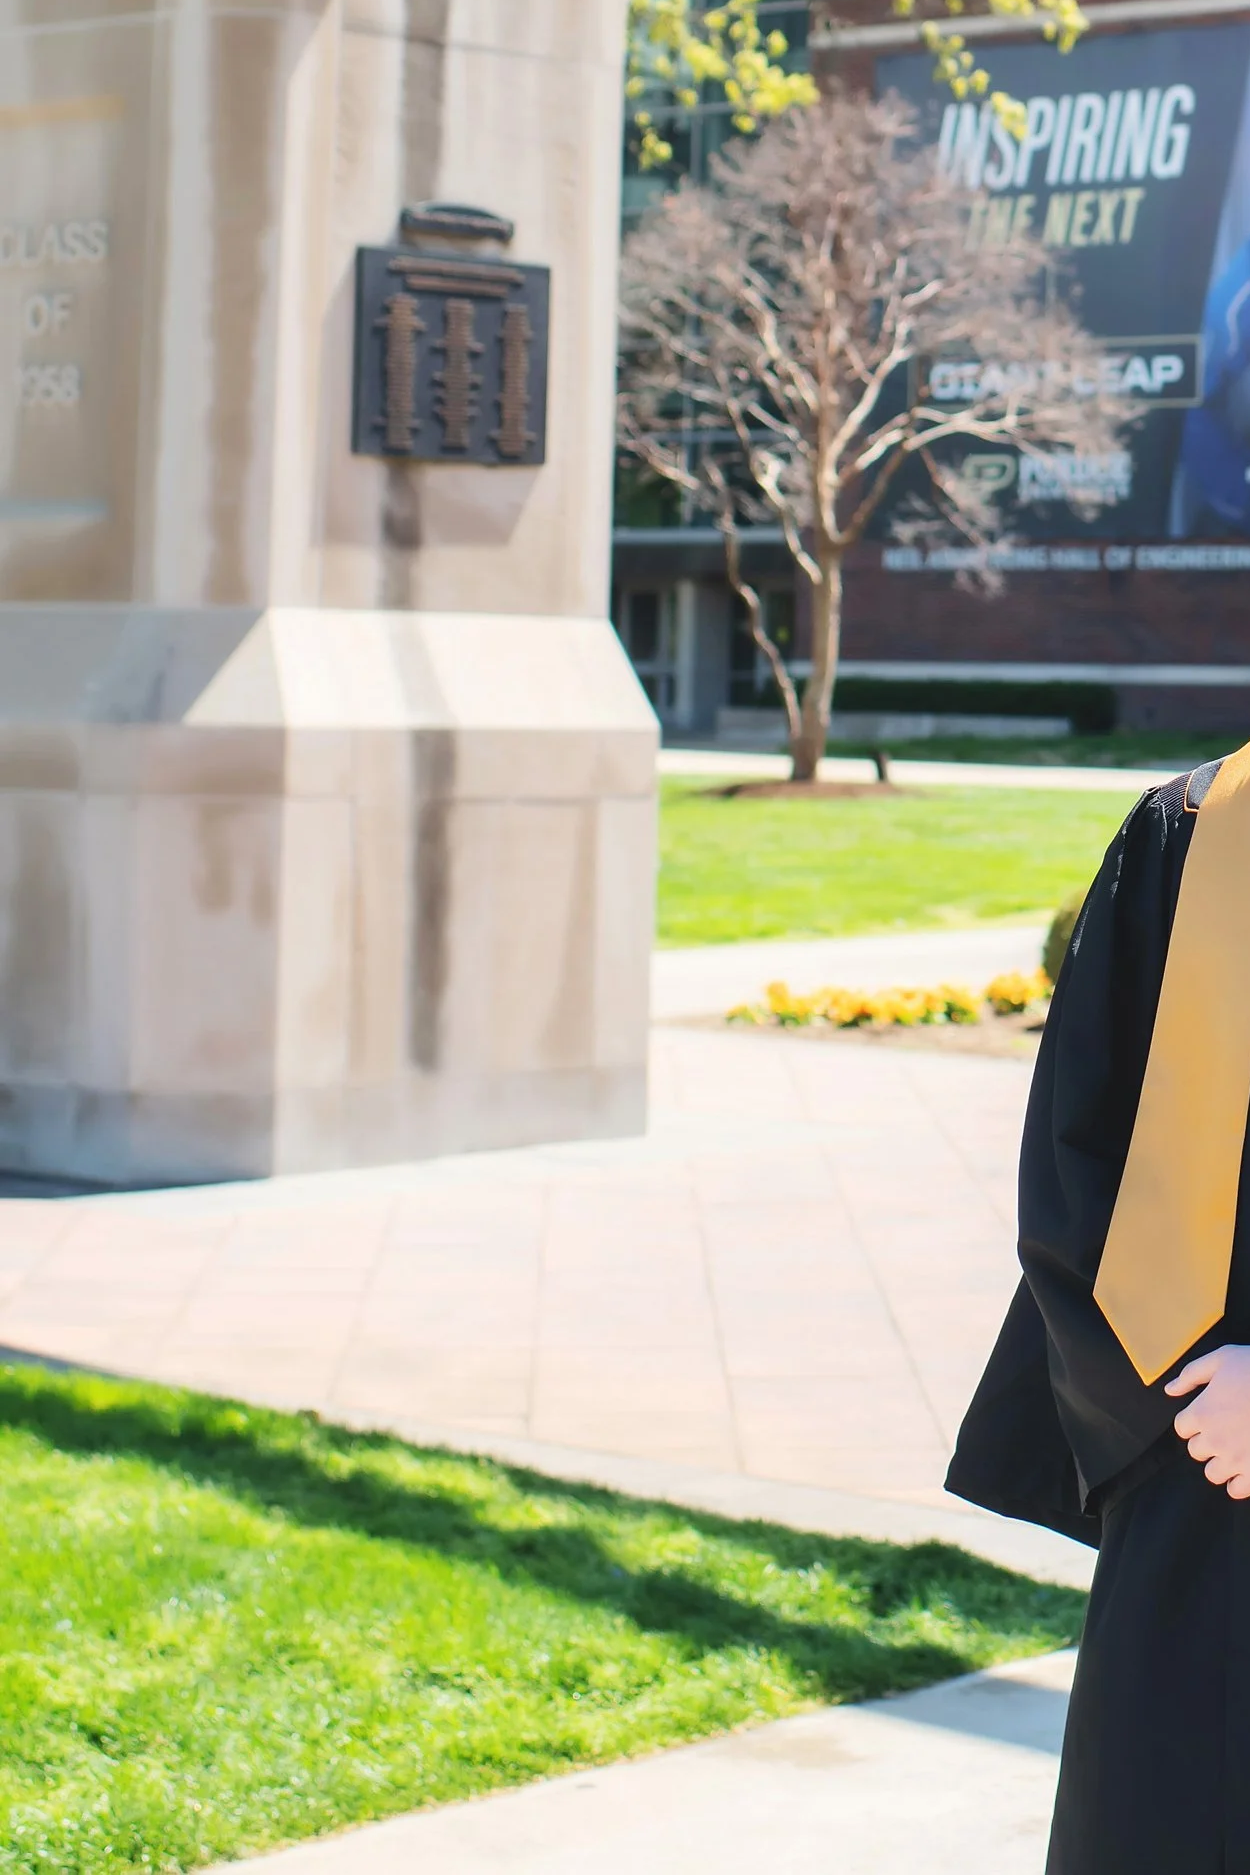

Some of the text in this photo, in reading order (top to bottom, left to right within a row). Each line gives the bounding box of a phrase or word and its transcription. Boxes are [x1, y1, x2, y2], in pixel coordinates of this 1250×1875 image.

[937, 83, 1196, 191] INSPIRING
[1041, 186, 1146, 248] NEXT
[24, 291, 74, 335] OF
